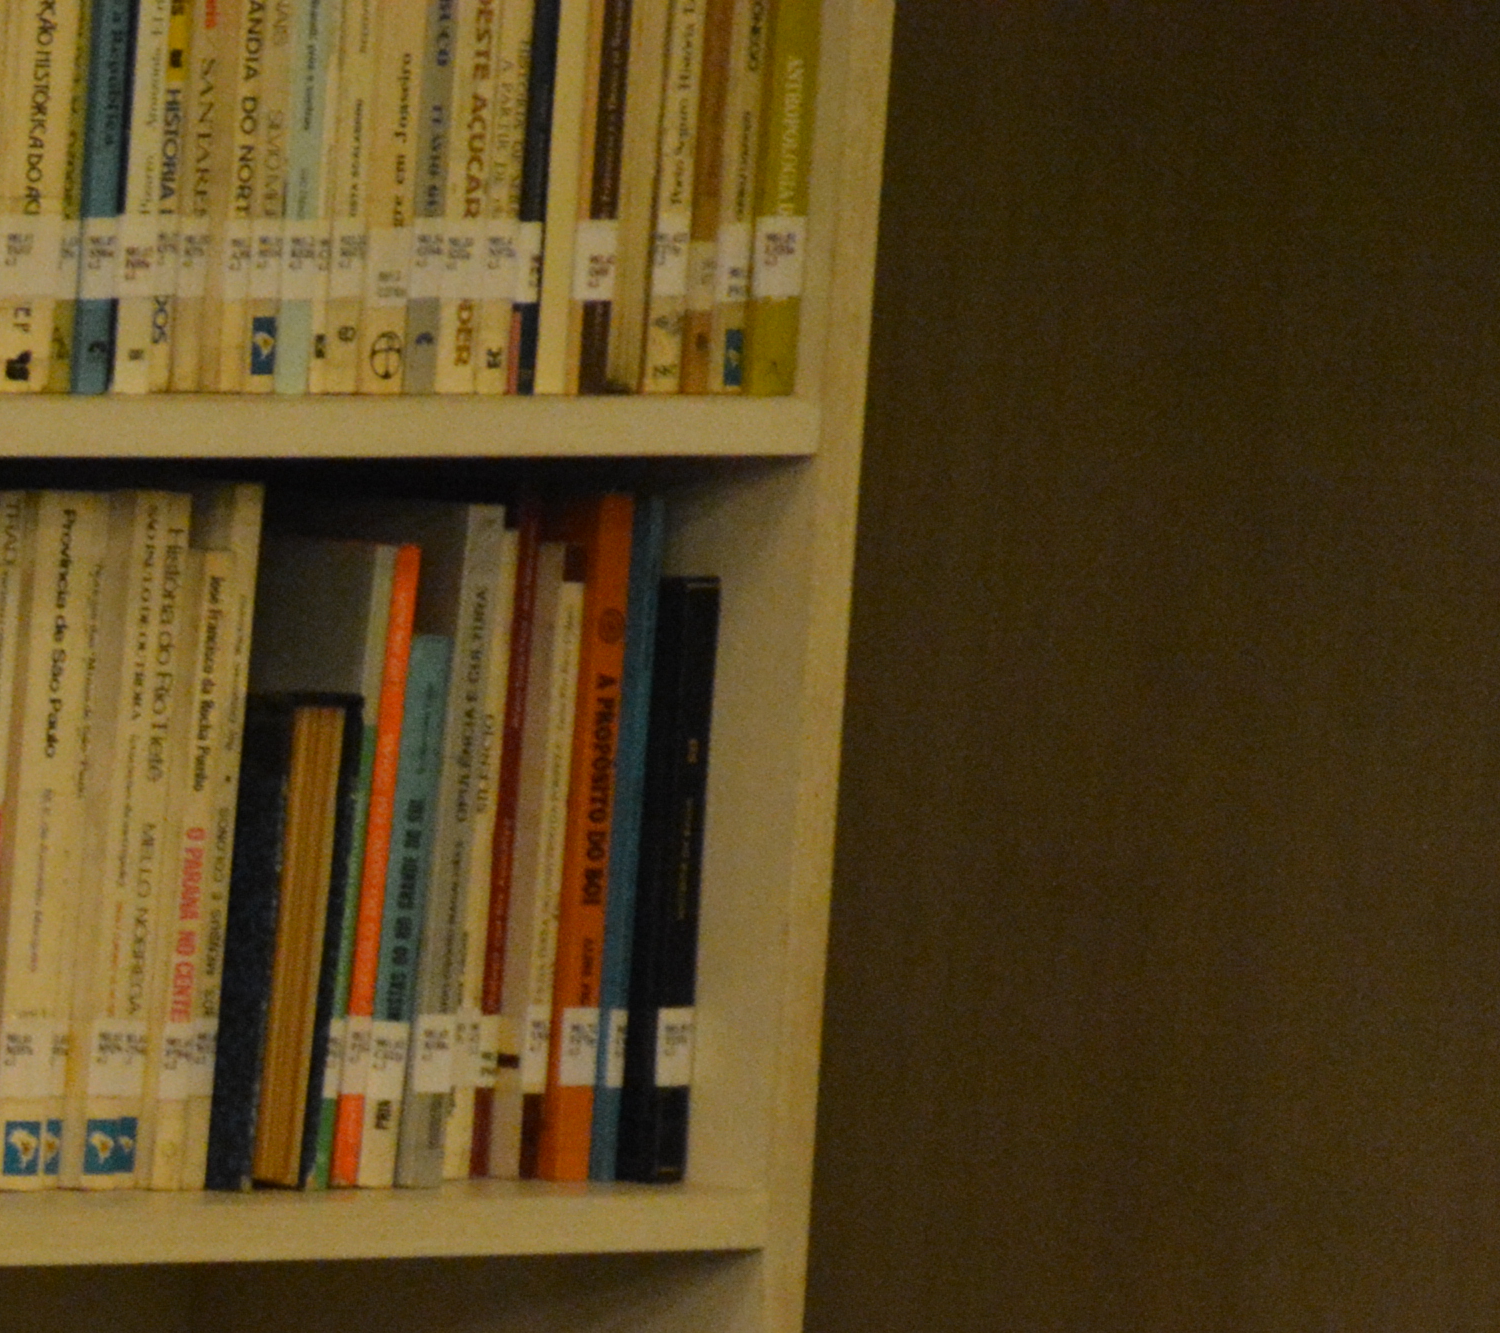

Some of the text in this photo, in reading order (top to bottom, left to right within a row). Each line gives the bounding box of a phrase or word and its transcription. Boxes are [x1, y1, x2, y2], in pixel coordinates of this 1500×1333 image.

[159, 527, 185, 625] História
[43, 508, 77, 759] Província de São Paulo
[155, 631, 176, 666] do
[150, 670, 171, 715] Rio
[454, 587, 488, 823] OPULÊNCIA E CULTURA
[582, 673, 615, 906] A PROPÓSITO DO BOI
[135, 823, 157, 898] MELLO
